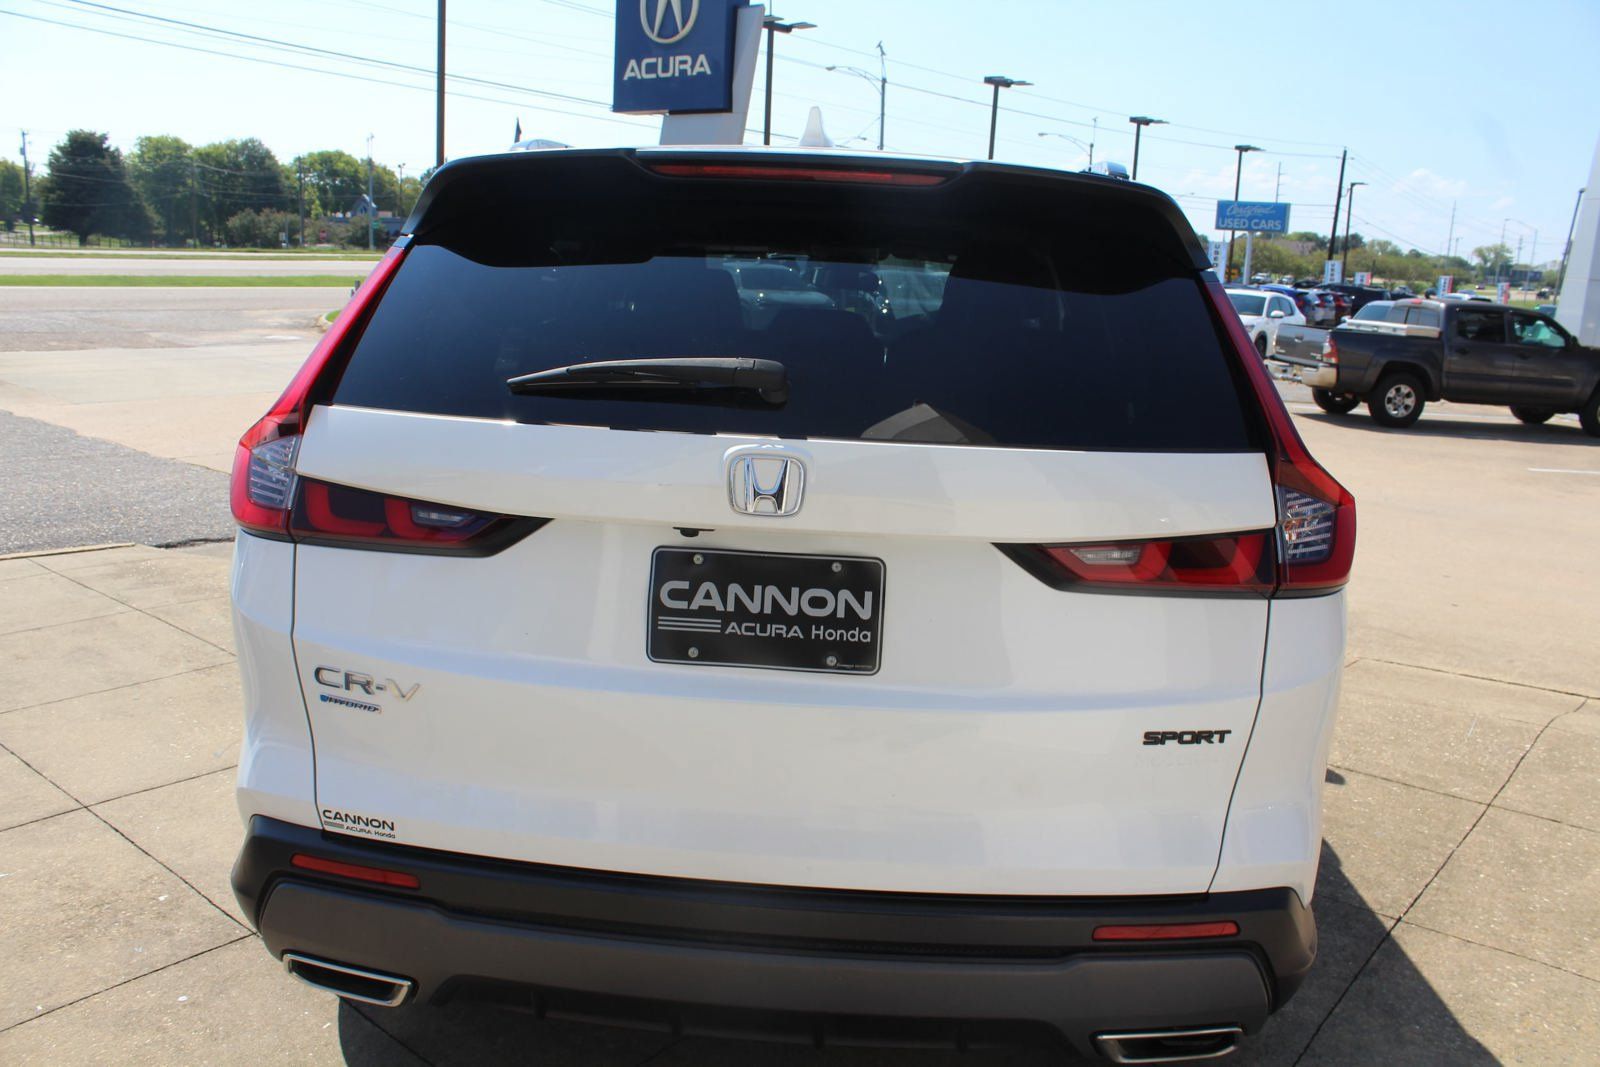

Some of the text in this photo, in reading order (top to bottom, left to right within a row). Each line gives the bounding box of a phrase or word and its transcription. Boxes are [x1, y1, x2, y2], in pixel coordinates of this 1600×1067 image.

[623, 54, 712, 81] ACURA
[1218, 218, 1282, 230] USED CARS
[659, 580, 873, 621] CANNON
[725, 621, 872, 643] ACURA Honda
[314, 666, 421, 702] CR-V
[1142, 729, 1232, 746] SPORT
[322, 809, 395, 832] CANNON
[345, 825, 396, 839] ACURA Honda
